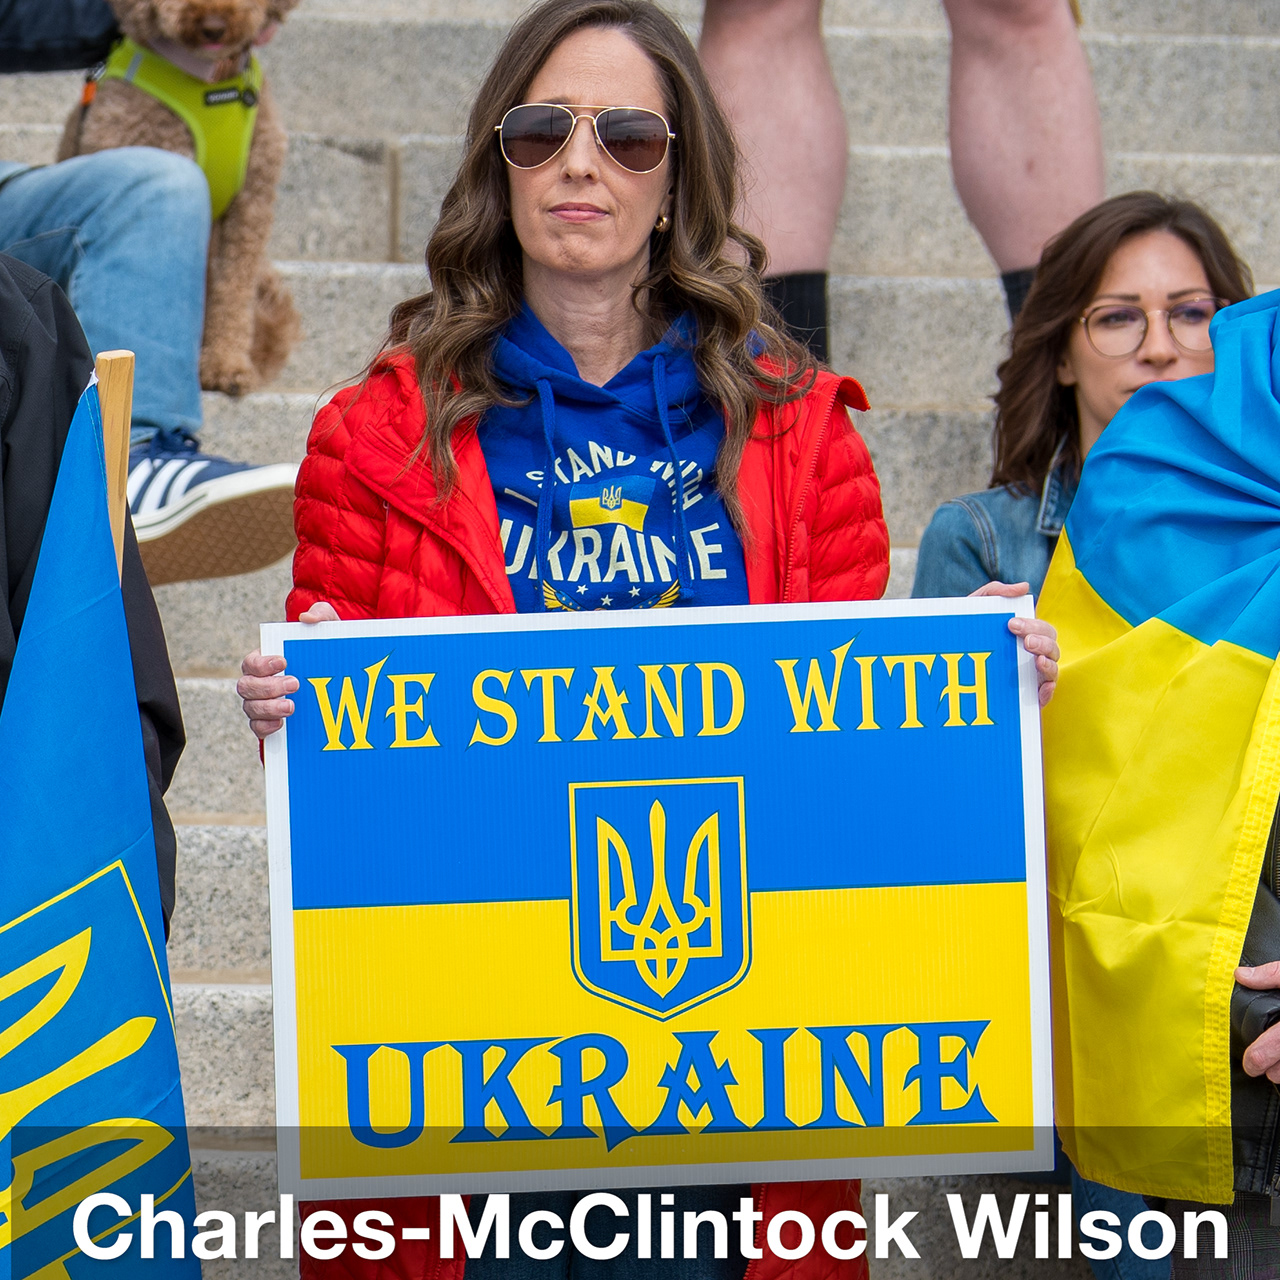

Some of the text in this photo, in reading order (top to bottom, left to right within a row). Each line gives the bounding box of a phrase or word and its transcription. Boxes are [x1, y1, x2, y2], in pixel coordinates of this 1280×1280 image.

[498, 514, 728, 584] UKRAINE
[308, 636, 995, 752] WE STAND WITH
[331, 1019, 1001, 1152] UKRAINE
